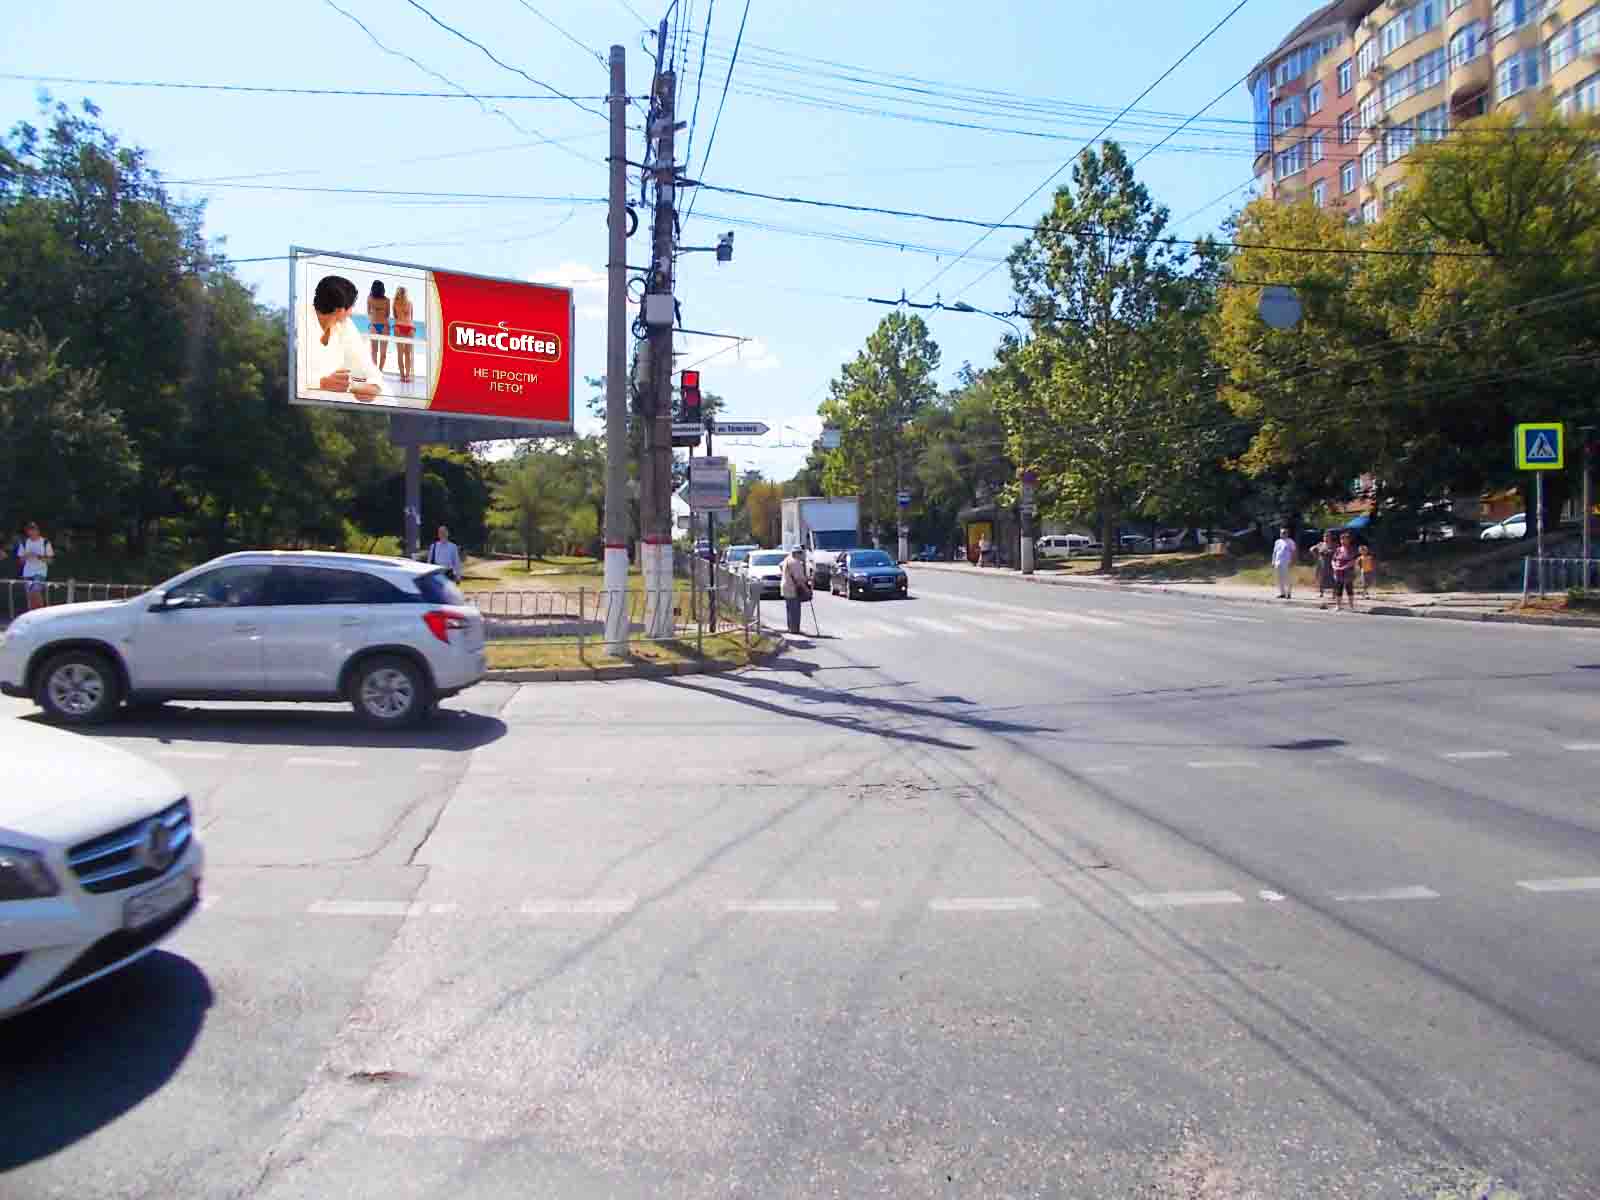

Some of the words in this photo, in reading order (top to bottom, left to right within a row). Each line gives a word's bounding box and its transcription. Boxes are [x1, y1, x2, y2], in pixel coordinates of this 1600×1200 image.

[455, 326, 556, 355] MacCoffee
[473, 367, 489, 378] НЕ
[492, 369, 538, 384] ПРОСПИ
[490, 381, 523, 395] ЛЕТО!
